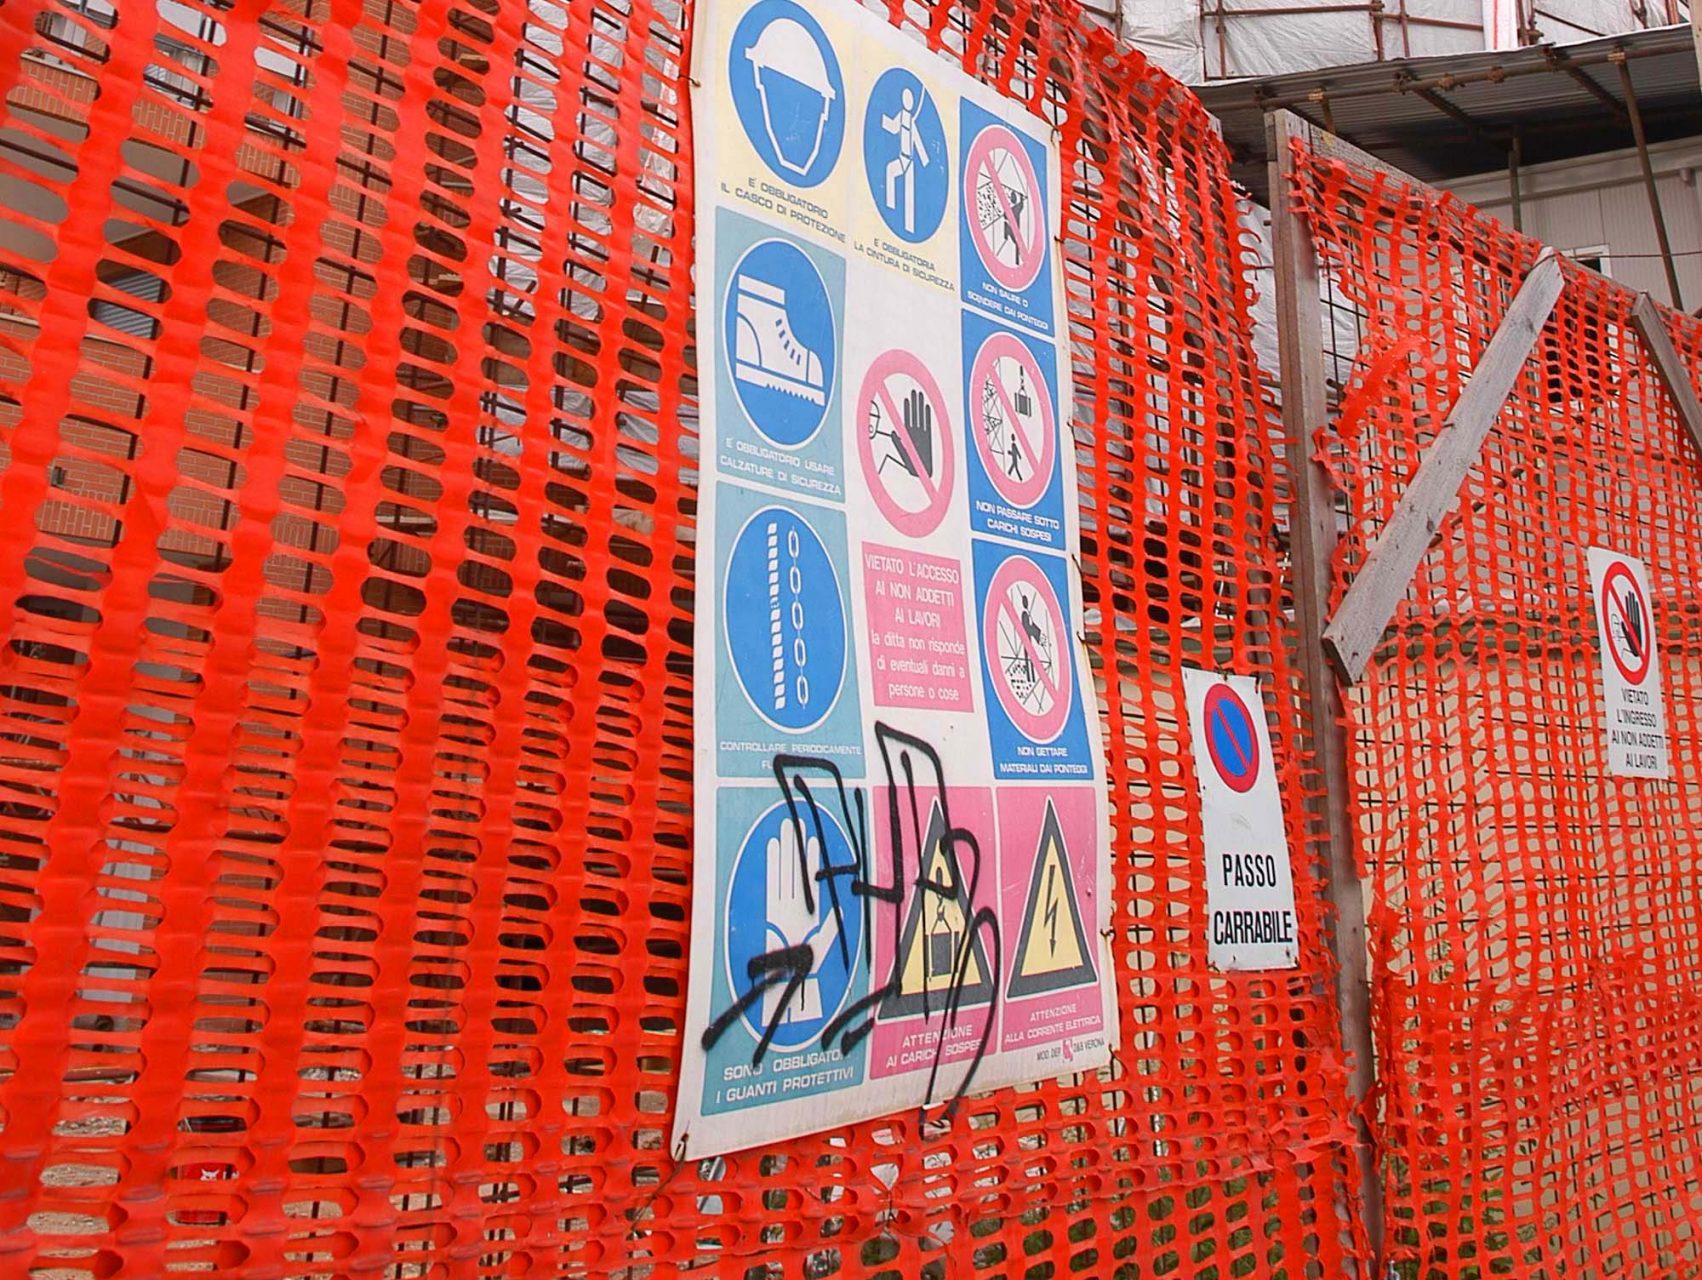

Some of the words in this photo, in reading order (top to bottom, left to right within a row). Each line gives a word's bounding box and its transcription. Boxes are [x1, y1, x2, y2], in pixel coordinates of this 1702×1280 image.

[720, 181, 731, 194] IL
[735, 187, 774, 210] CASCO
[776, 203, 788, 216] DI
[790, 209, 847, 243] PROTEZIONE
[760, 182, 829, 219] OBBLIGATORIO
[854, 241, 865, 252] LA
[866, 247, 901, 269] CINTURA
[912, 267, 956, 292] SICUREZZA
[882, 242, 935, 272] OBBLIGATORIA
[736, 440, 801, 468] OBBLIGATORIO
[804, 459, 835, 476] USARE
[719, 455, 775, 480] CALZATURE
[777, 471, 788, 483] DI
[790, 474, 841, 496] SICUREZZA
[975, 500, 996, 514] NON
[996, 505, 1033, 524] PASSARE
[1034, 515, 1060, 530] SOTTO
[864, 553, 904, 575] VIETATO
[908, 560, 961, 585] L'ACCESSO
[875, 579, 887, 597] AI
[889, 581, 913, 600] NON
[915, 586, 956, 608] ADDETTI
[894, 606, 906, 624] AI
[907, 609, 941, 629] LAVORI
[870, 629, 881, 646] la
[883, 631, 906, 649] ditta
[908, 637, 926, 650] non
[928, 638, 966, 657] risponde
[876, 654, 886, 671] di
[889, 658, 929, 675] eventuali
[931, 661, 957, 678] danni
[959, 666, 966, 680] a
[888, 682, 926, 700] persone
[928, 686, 936, 700] o
[937, 686, 960, 702] cose
[1621, 688, 1649, 705] VIETATO
[719, 741, 787, 754] CONTROLLARE
[791, 743, 863, 756] PERIODICAMENTE
[1016, 746, 1035, 757] NON
[1035, 747, 1069, 758] GETTARE
[1620, 730, 1638, 747] NON
[1000, 762, 1039, 773] MATERIALI
[1039, 763, 1053, 774] DAI
[1634, 753, 1657, 770] LAVORI
[1222, 853, 1277, 888] PASSO
[1213, 910, 1293, 945] CARRABILE
[1030, 1003, 1077, 1023] ATTENZIONE
[1004, 1030, 1025, 1044] ALLA
[1026, 1022, 1065, 1039] CORRENTE
[1065, 1014, 1101, 1030] ELETTRICA
[773, 1048, 850, 1073] OBBLIGATO
[886, 1054, 898, 1069] AI
[715, 1090, 721, 1104] I
[726, 1081, 777, 1102] GUANTI
[782, 1066, 855, 1093] PROTETTIVI
